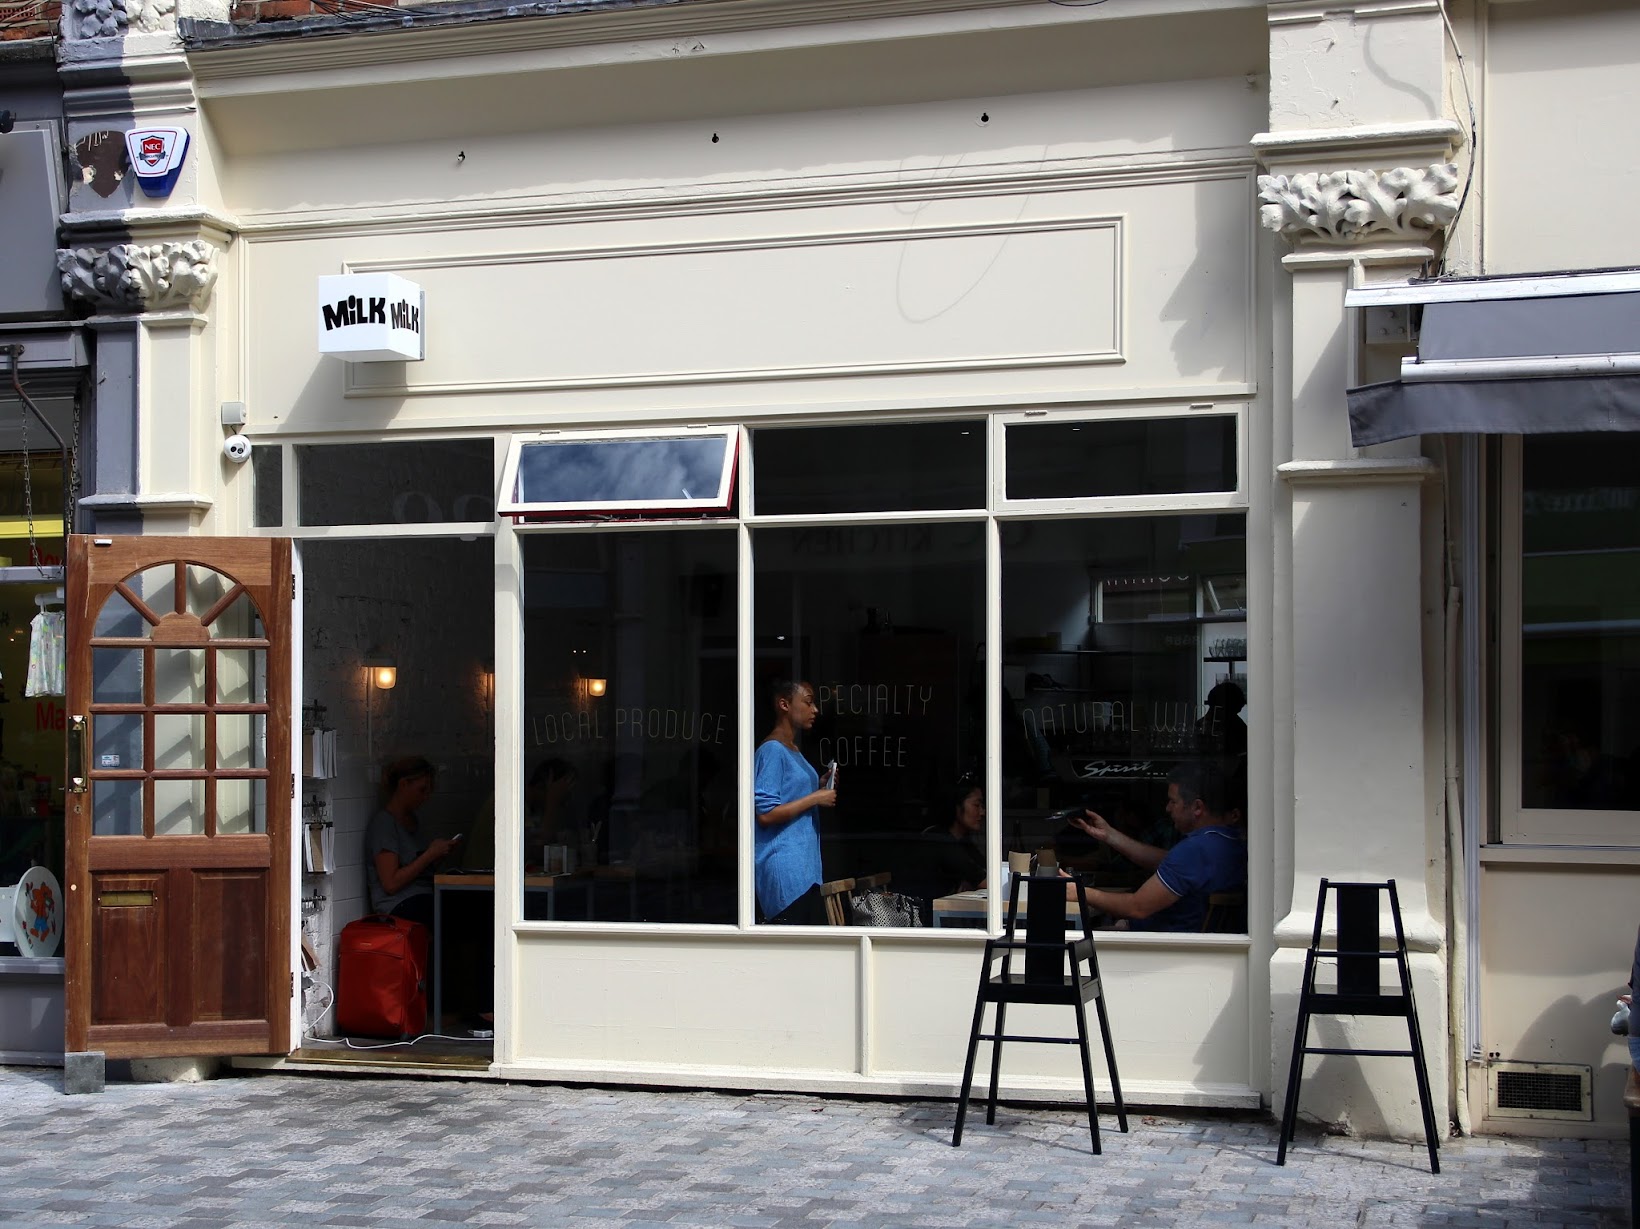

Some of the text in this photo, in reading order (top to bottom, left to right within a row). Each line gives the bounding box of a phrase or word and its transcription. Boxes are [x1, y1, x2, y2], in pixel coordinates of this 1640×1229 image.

[144, 143, 161, 151] NEC
[533, 708, 727, 746] LOCAL PRODUCE
[1023, 701, 1224, 740] NATURAL WINE
[819, 736, 907, 768] COFFEE
[1078, 760, 1153, 779] Spirit
